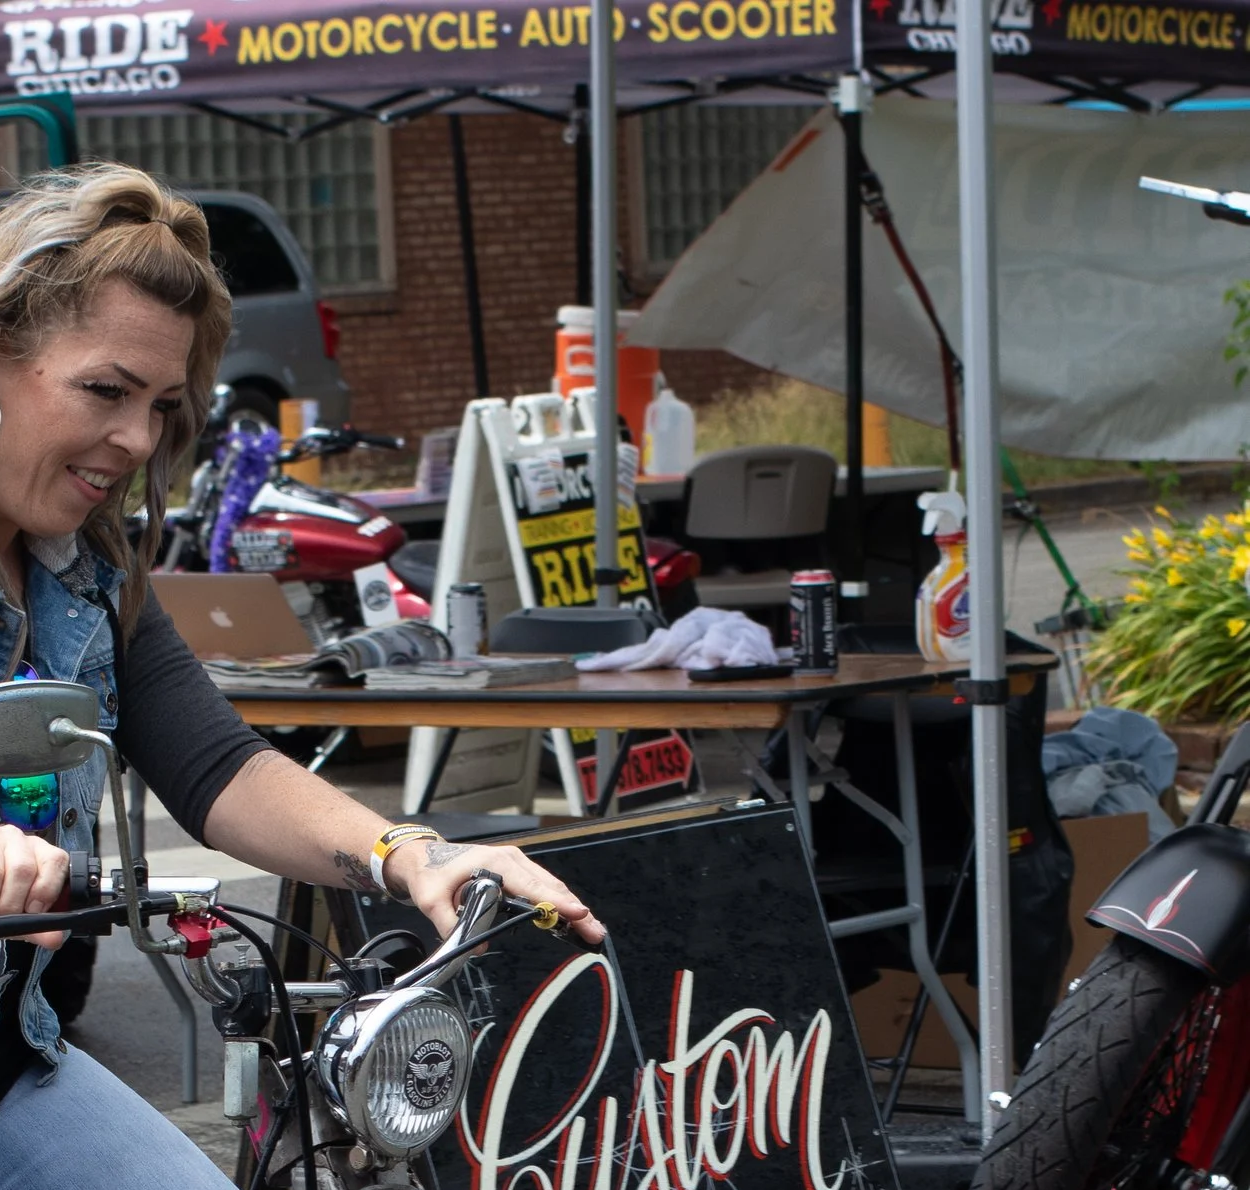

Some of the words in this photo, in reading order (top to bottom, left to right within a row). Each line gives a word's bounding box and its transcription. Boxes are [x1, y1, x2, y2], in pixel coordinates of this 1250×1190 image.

[4, 9, 194, 76] RIDE
[237, 9, 498, 64] MOTORCYCLE
[647, 0, 838, 43] SCOOTER
[1066, 4, 1235, 49] MOTORCYCLE
[14, 64, 180, 97] CHICAGO
[533, 534, 649, 608] RIE
[413, 1042, 452, 1061] MOTOBLOT
[406, 1080, 434, 1108] GASOLINE
[434, 1076, 452, 1103] ALLEY
